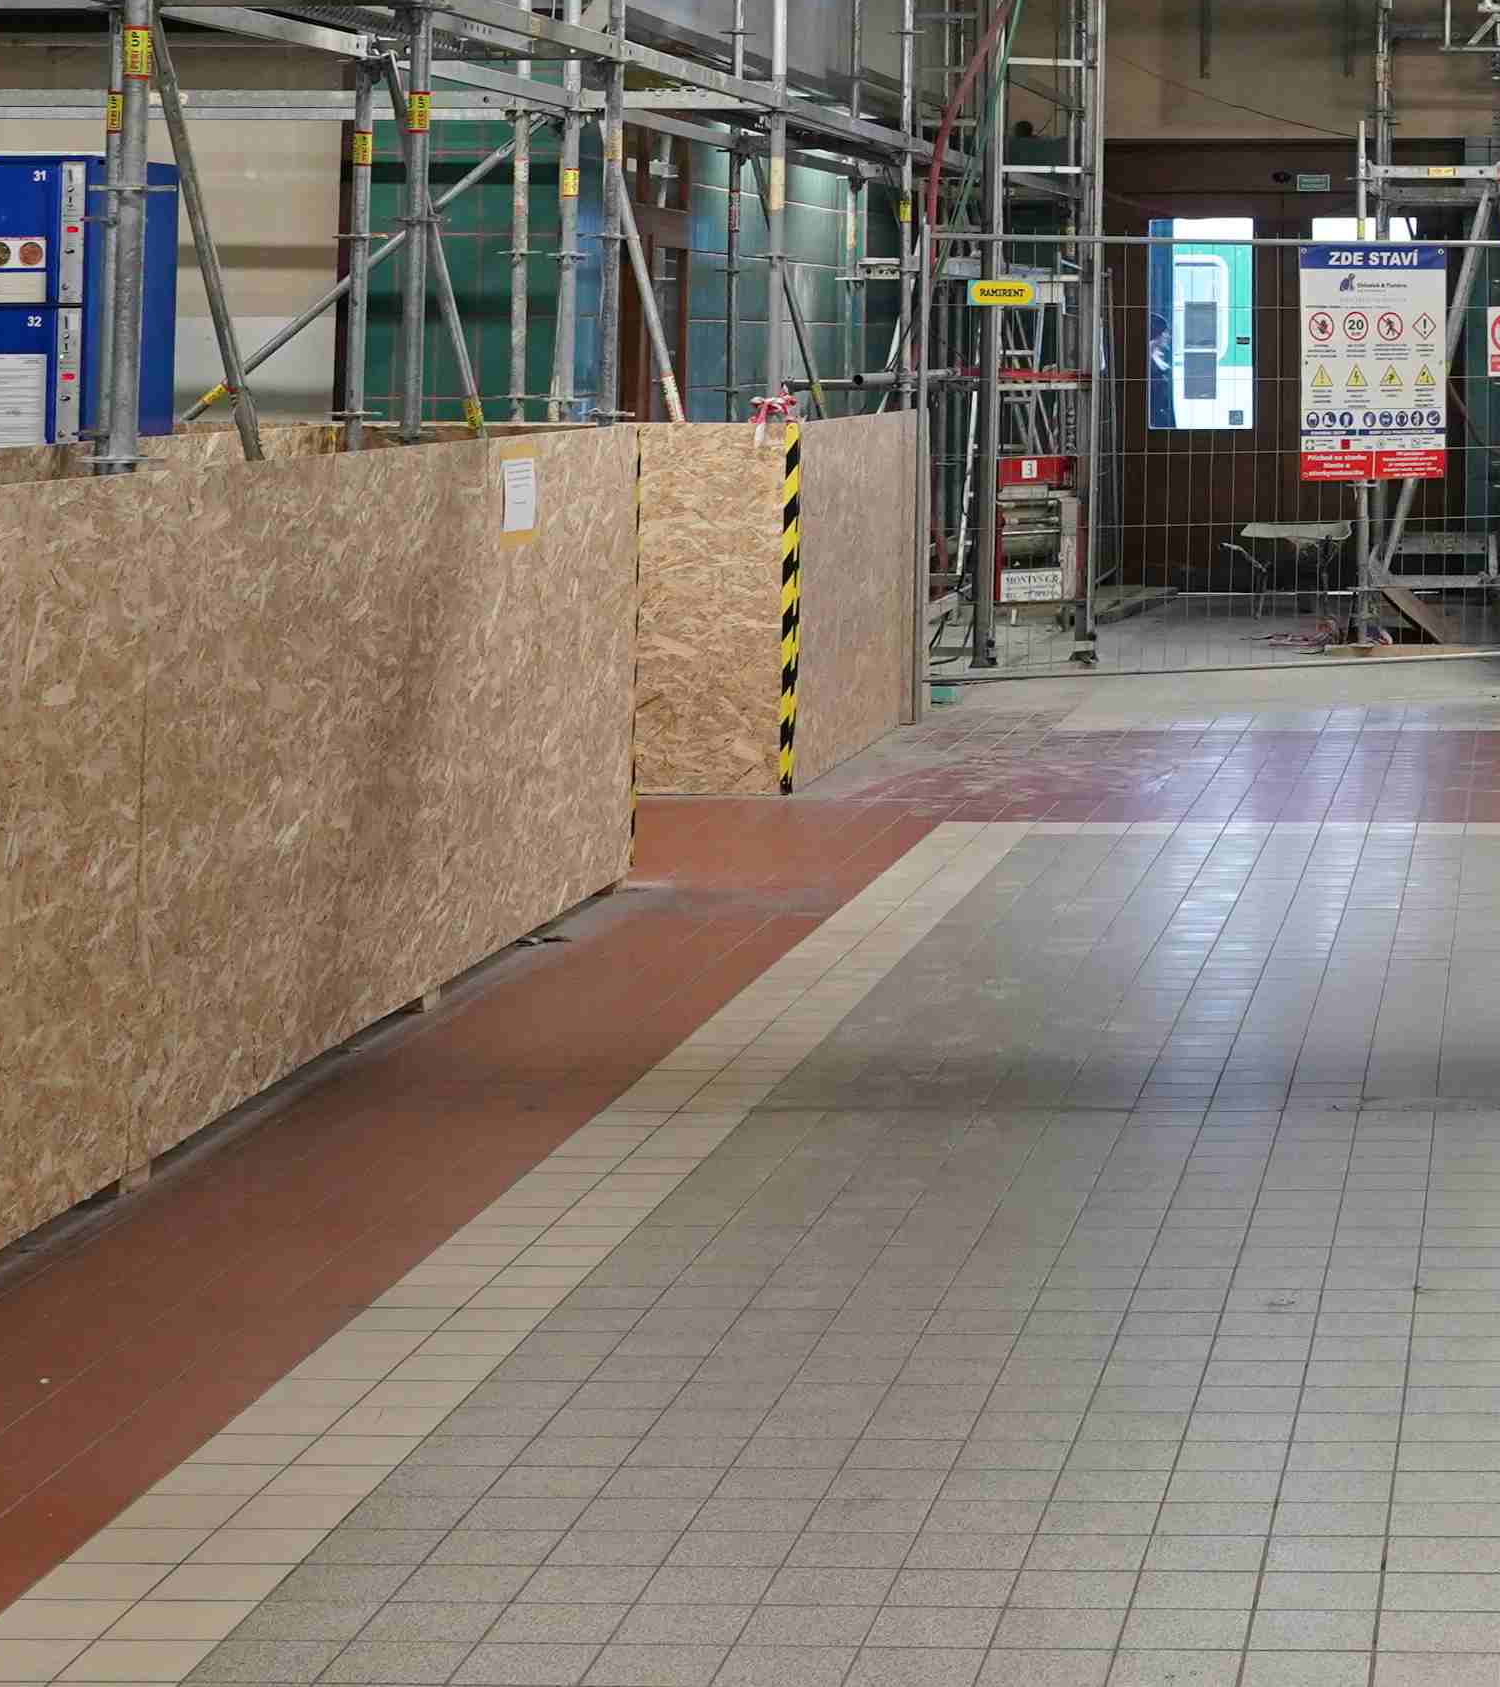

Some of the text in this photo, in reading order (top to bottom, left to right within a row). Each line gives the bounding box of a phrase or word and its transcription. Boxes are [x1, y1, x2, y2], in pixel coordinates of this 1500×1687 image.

[130, 32, 140, 48] UP
[33, 170, 46, 182] 31
[1328, 249, 1419, 266] ZDE STAVÍ
[27, 315, 42, 327] 32
[1348, 319, 1364, 330] 20
